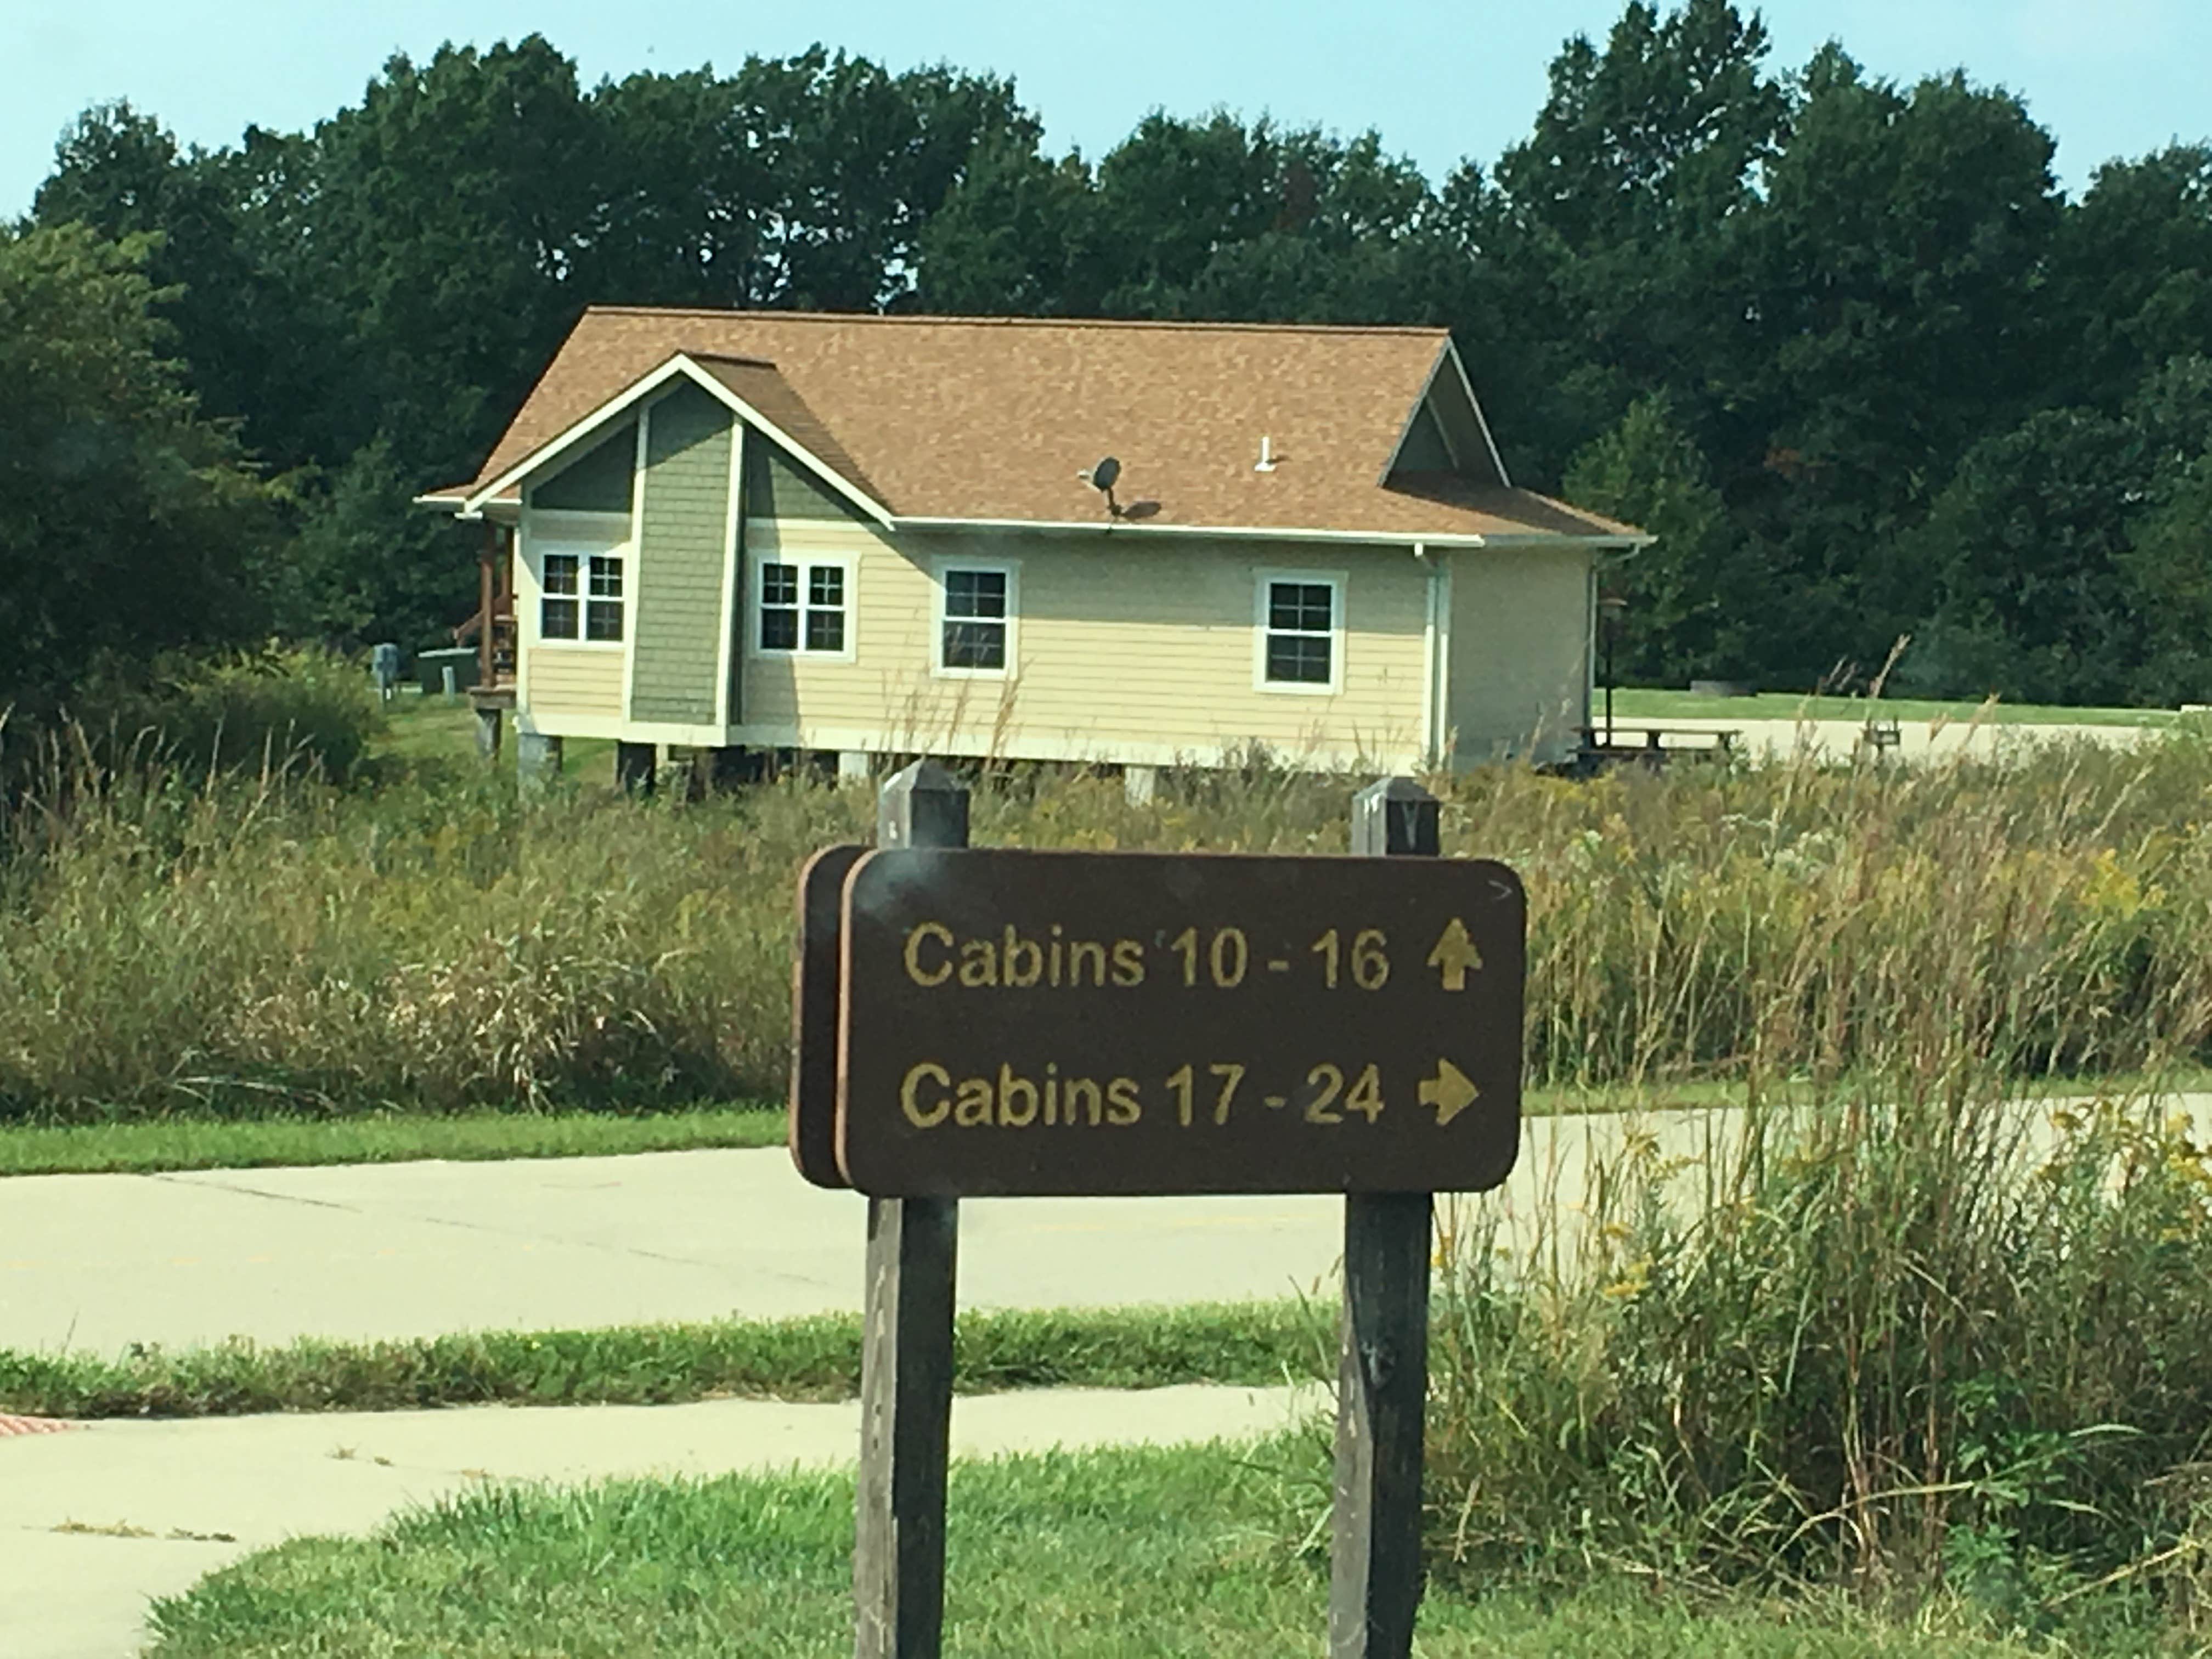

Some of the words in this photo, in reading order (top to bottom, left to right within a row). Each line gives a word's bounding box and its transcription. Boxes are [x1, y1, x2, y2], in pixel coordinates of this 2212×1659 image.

[904, 922, 1144, 988] Cabins
[1171, 927, 1248, 988] 10
[1312, 929, 1390, 989] 16
[900, 1062, 1142, 1128] Cabins
[1166, 1064, 1245, 1127] 17
[1306, 1064, 1385, 1124] 24
